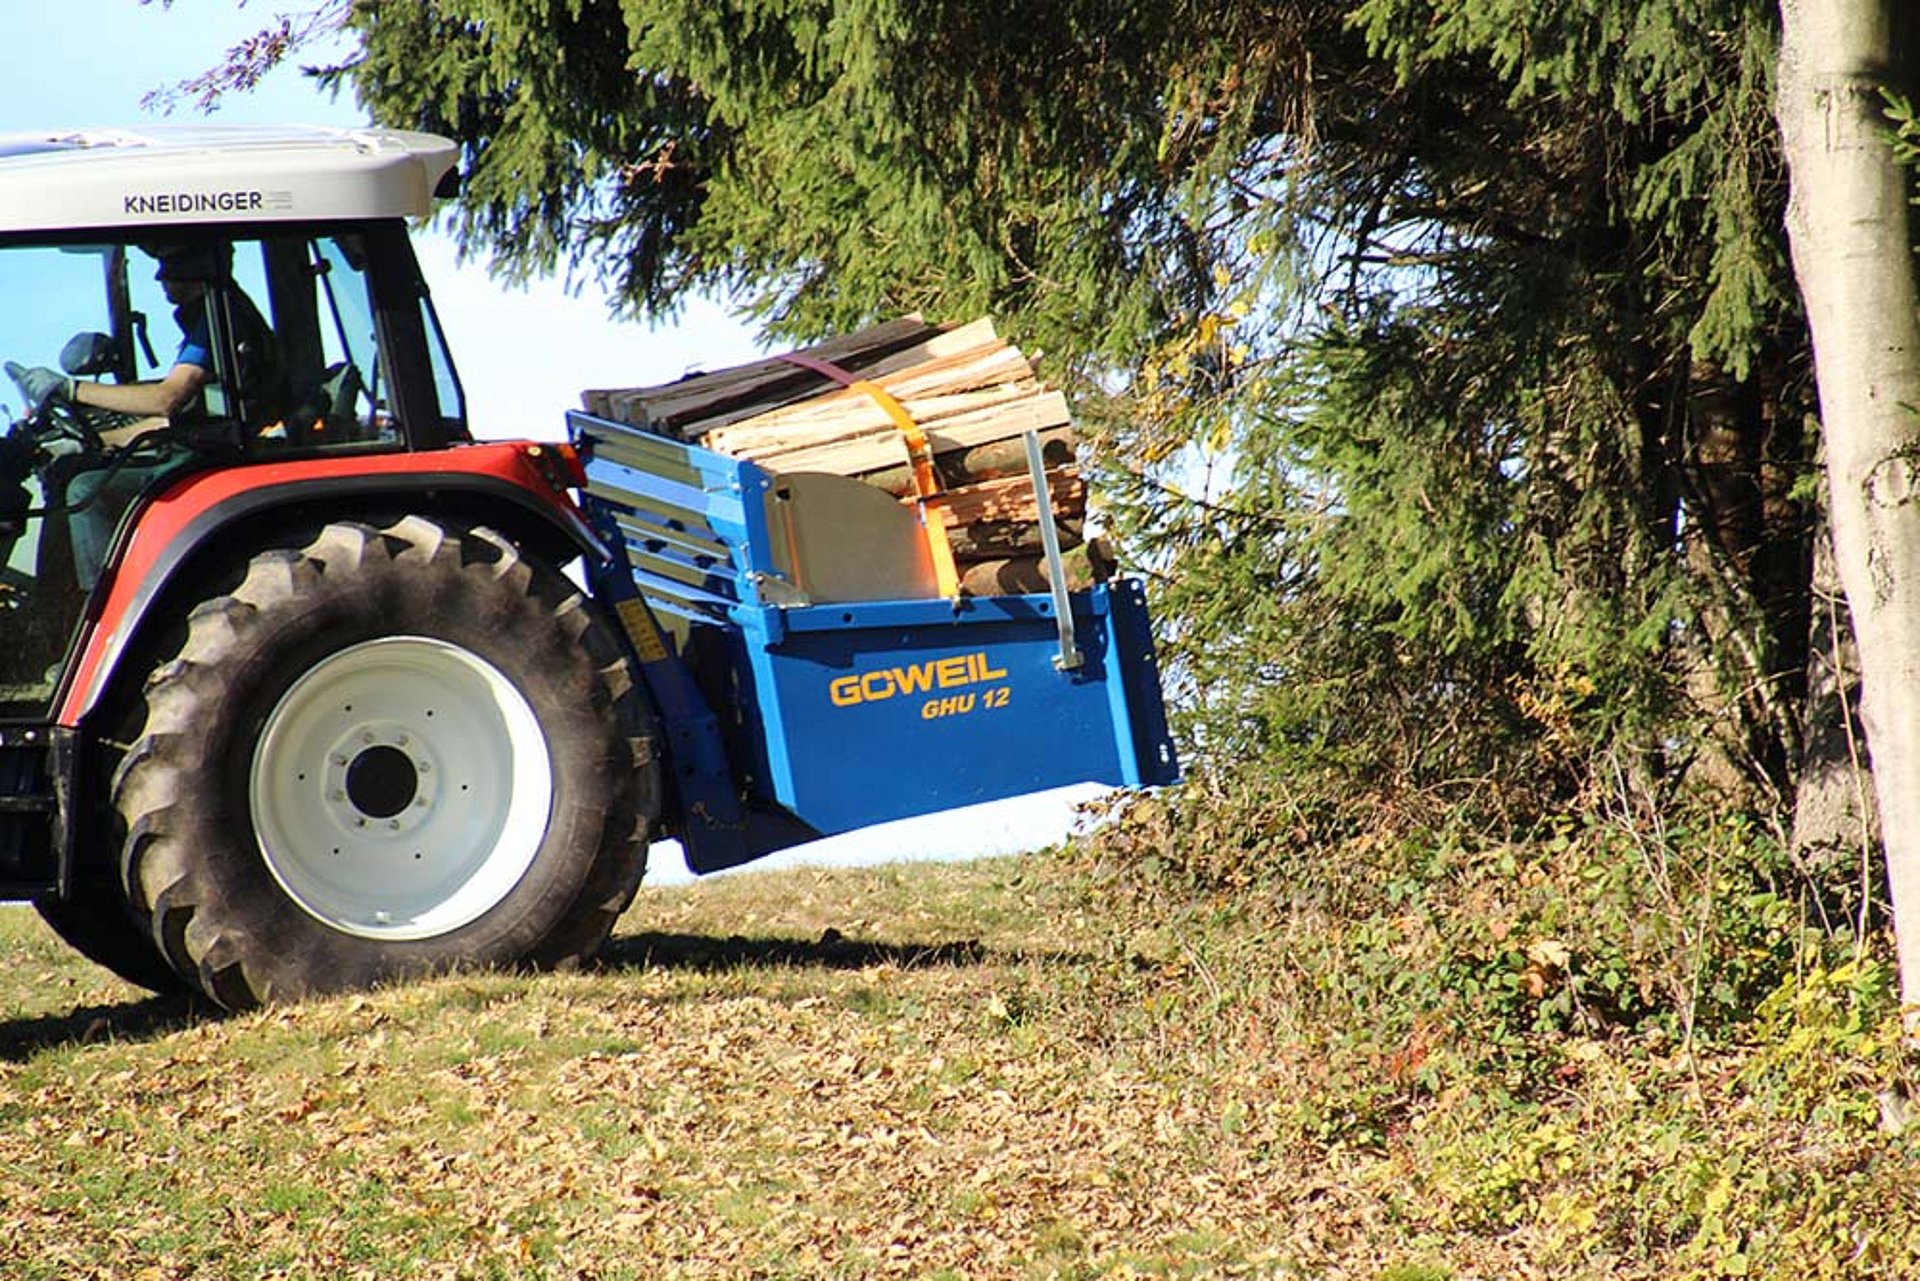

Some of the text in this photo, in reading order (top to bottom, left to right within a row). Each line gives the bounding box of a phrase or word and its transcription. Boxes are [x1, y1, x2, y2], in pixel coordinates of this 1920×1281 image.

[124, 191, 263, 213] KNEIDINGER
[921, 686, 1010, 719] GHU 12
